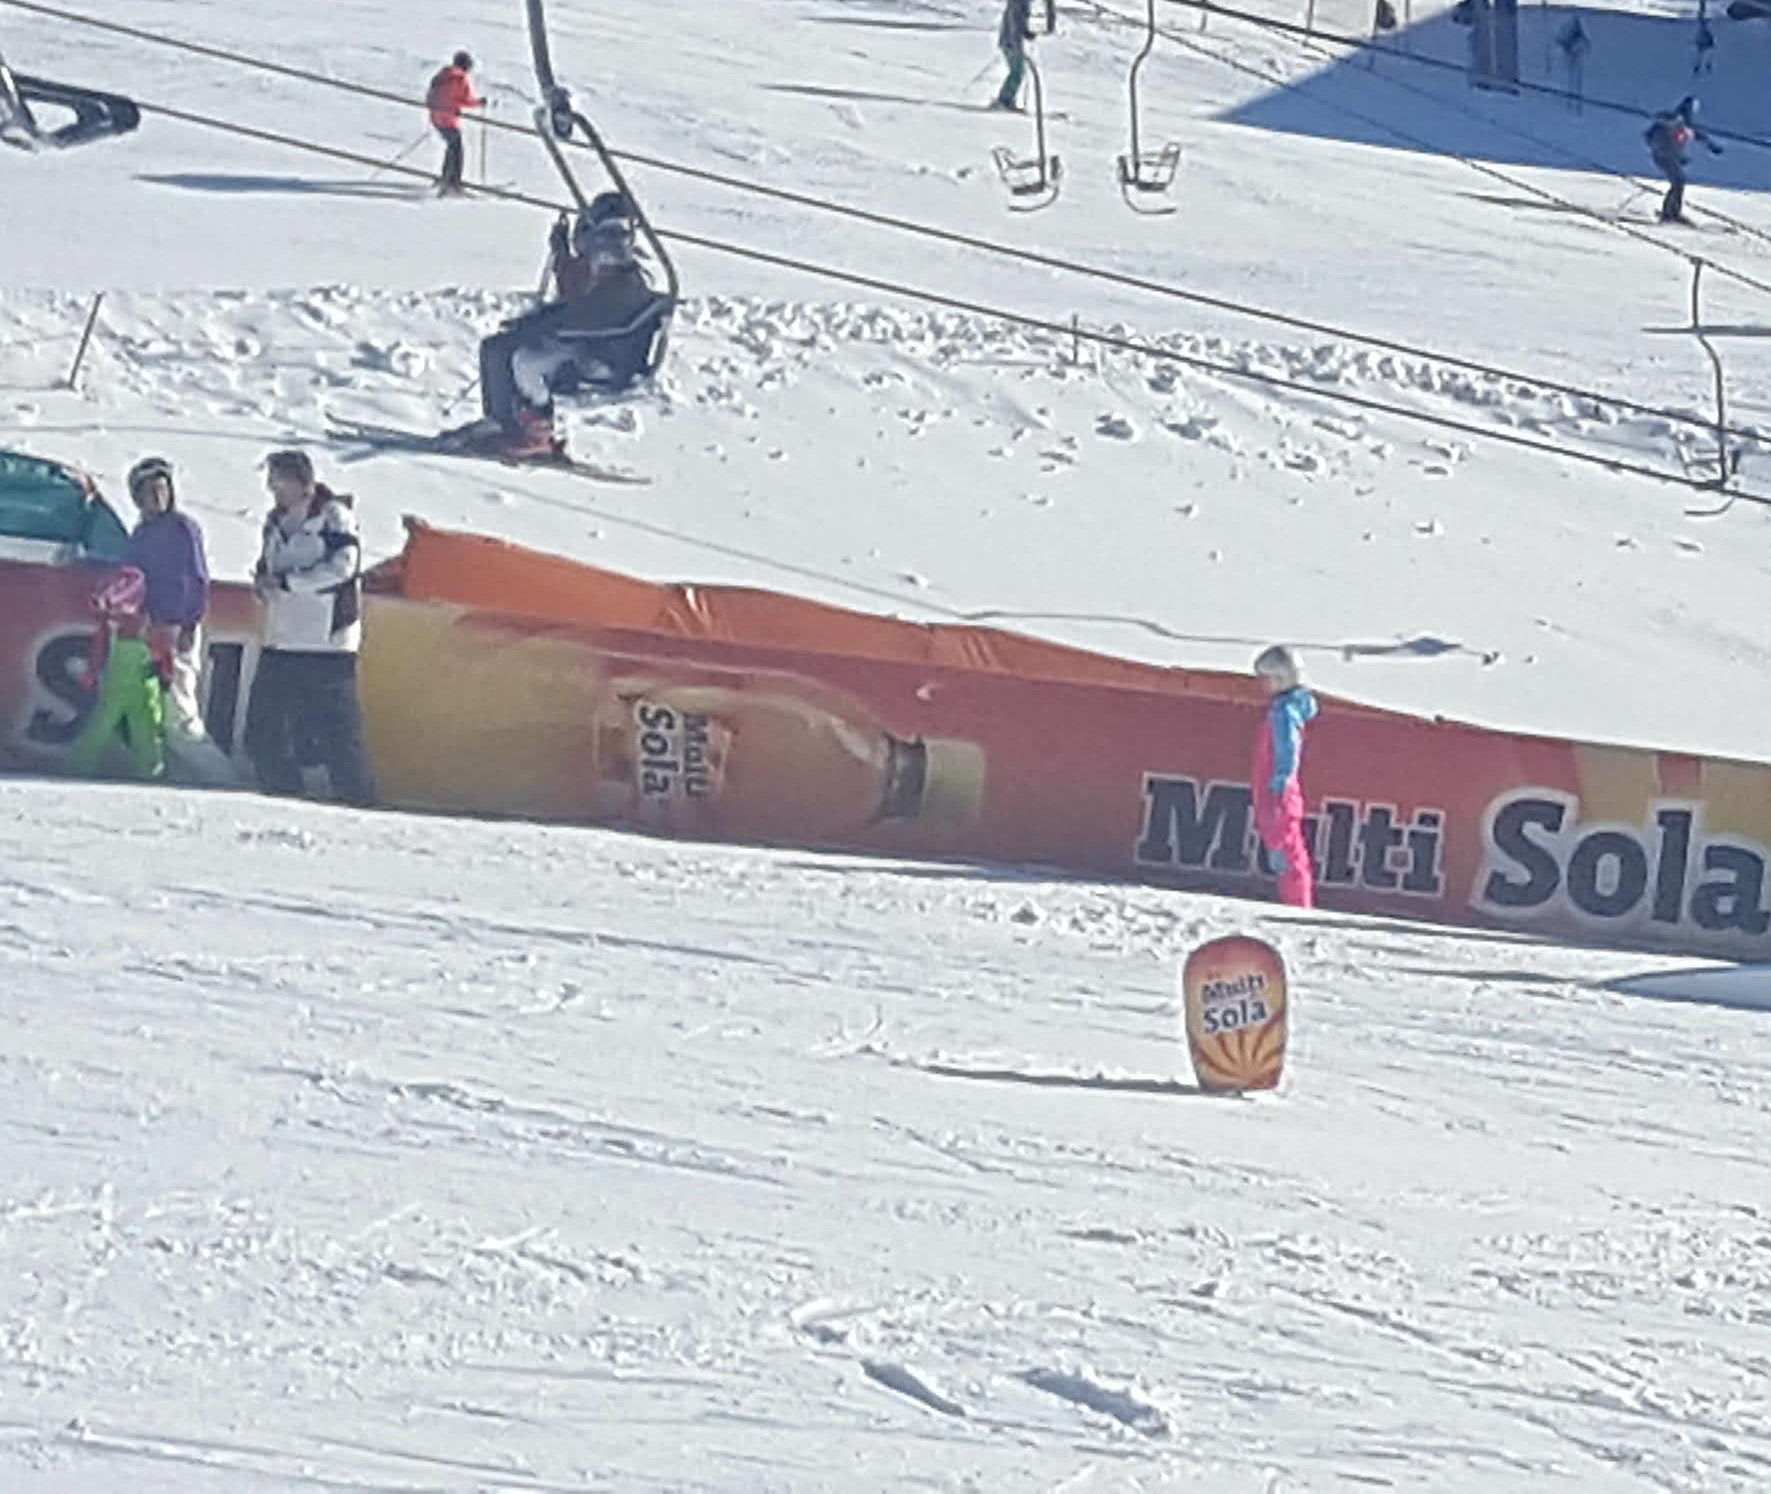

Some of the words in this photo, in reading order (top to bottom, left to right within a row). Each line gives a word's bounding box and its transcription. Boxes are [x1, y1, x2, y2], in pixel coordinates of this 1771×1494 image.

[638, 705, 679, 795] Sola
[1136, 776, 1444, 895] Mlti
[1203, 999, 1267, 1034] Sola
